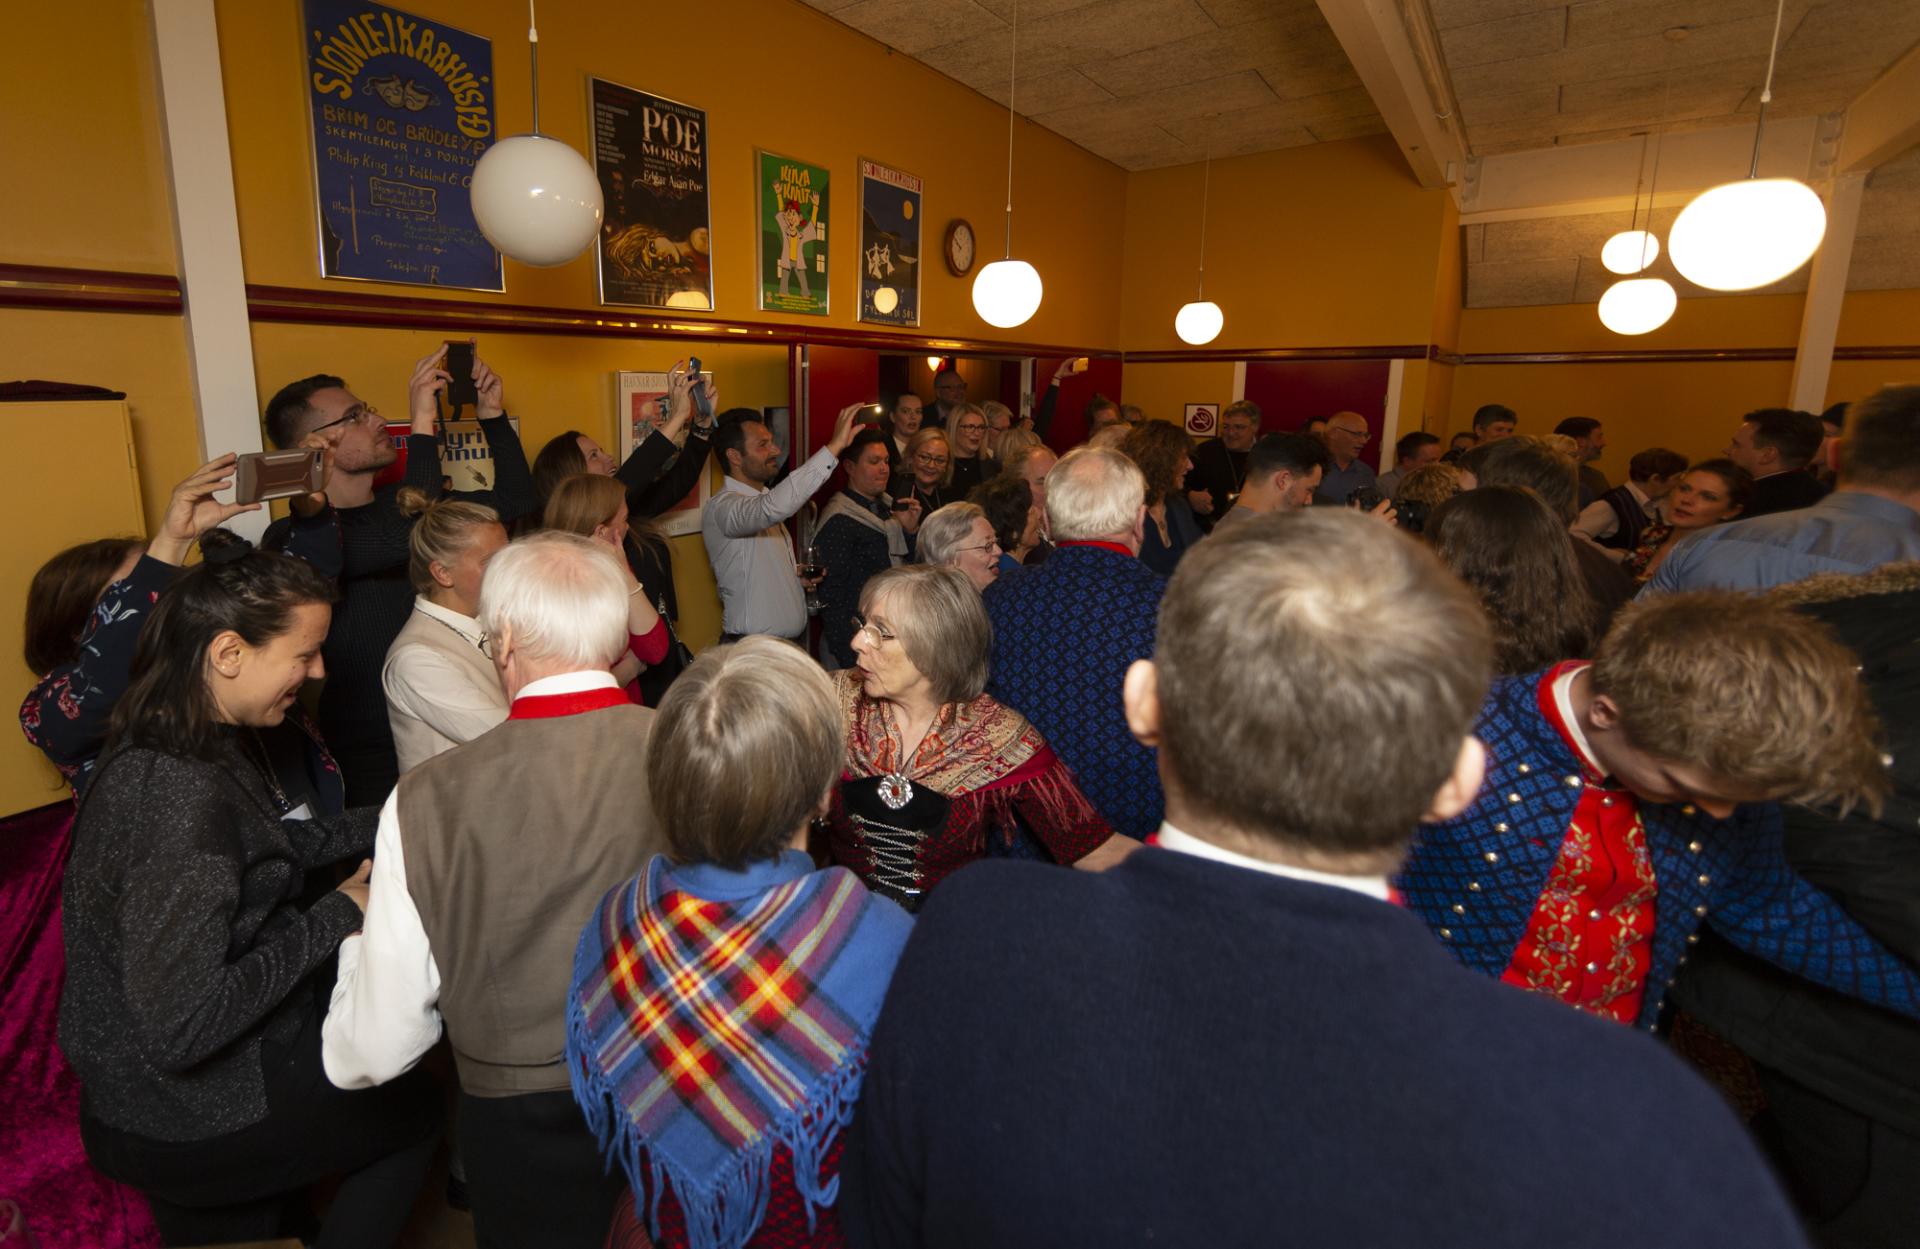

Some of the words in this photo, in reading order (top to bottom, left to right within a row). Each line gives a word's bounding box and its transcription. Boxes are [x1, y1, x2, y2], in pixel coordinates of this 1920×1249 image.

[322, 103, 369, 130] BRIM
[376, 117, 397, 136] OG
[642, 106, 700, 154] POE
[326, 146, 359, 169] Philip
[360, 153, 387, 177] King
[689, 178, 704, 193] Poe
[447, 427, 482, 449] yri
